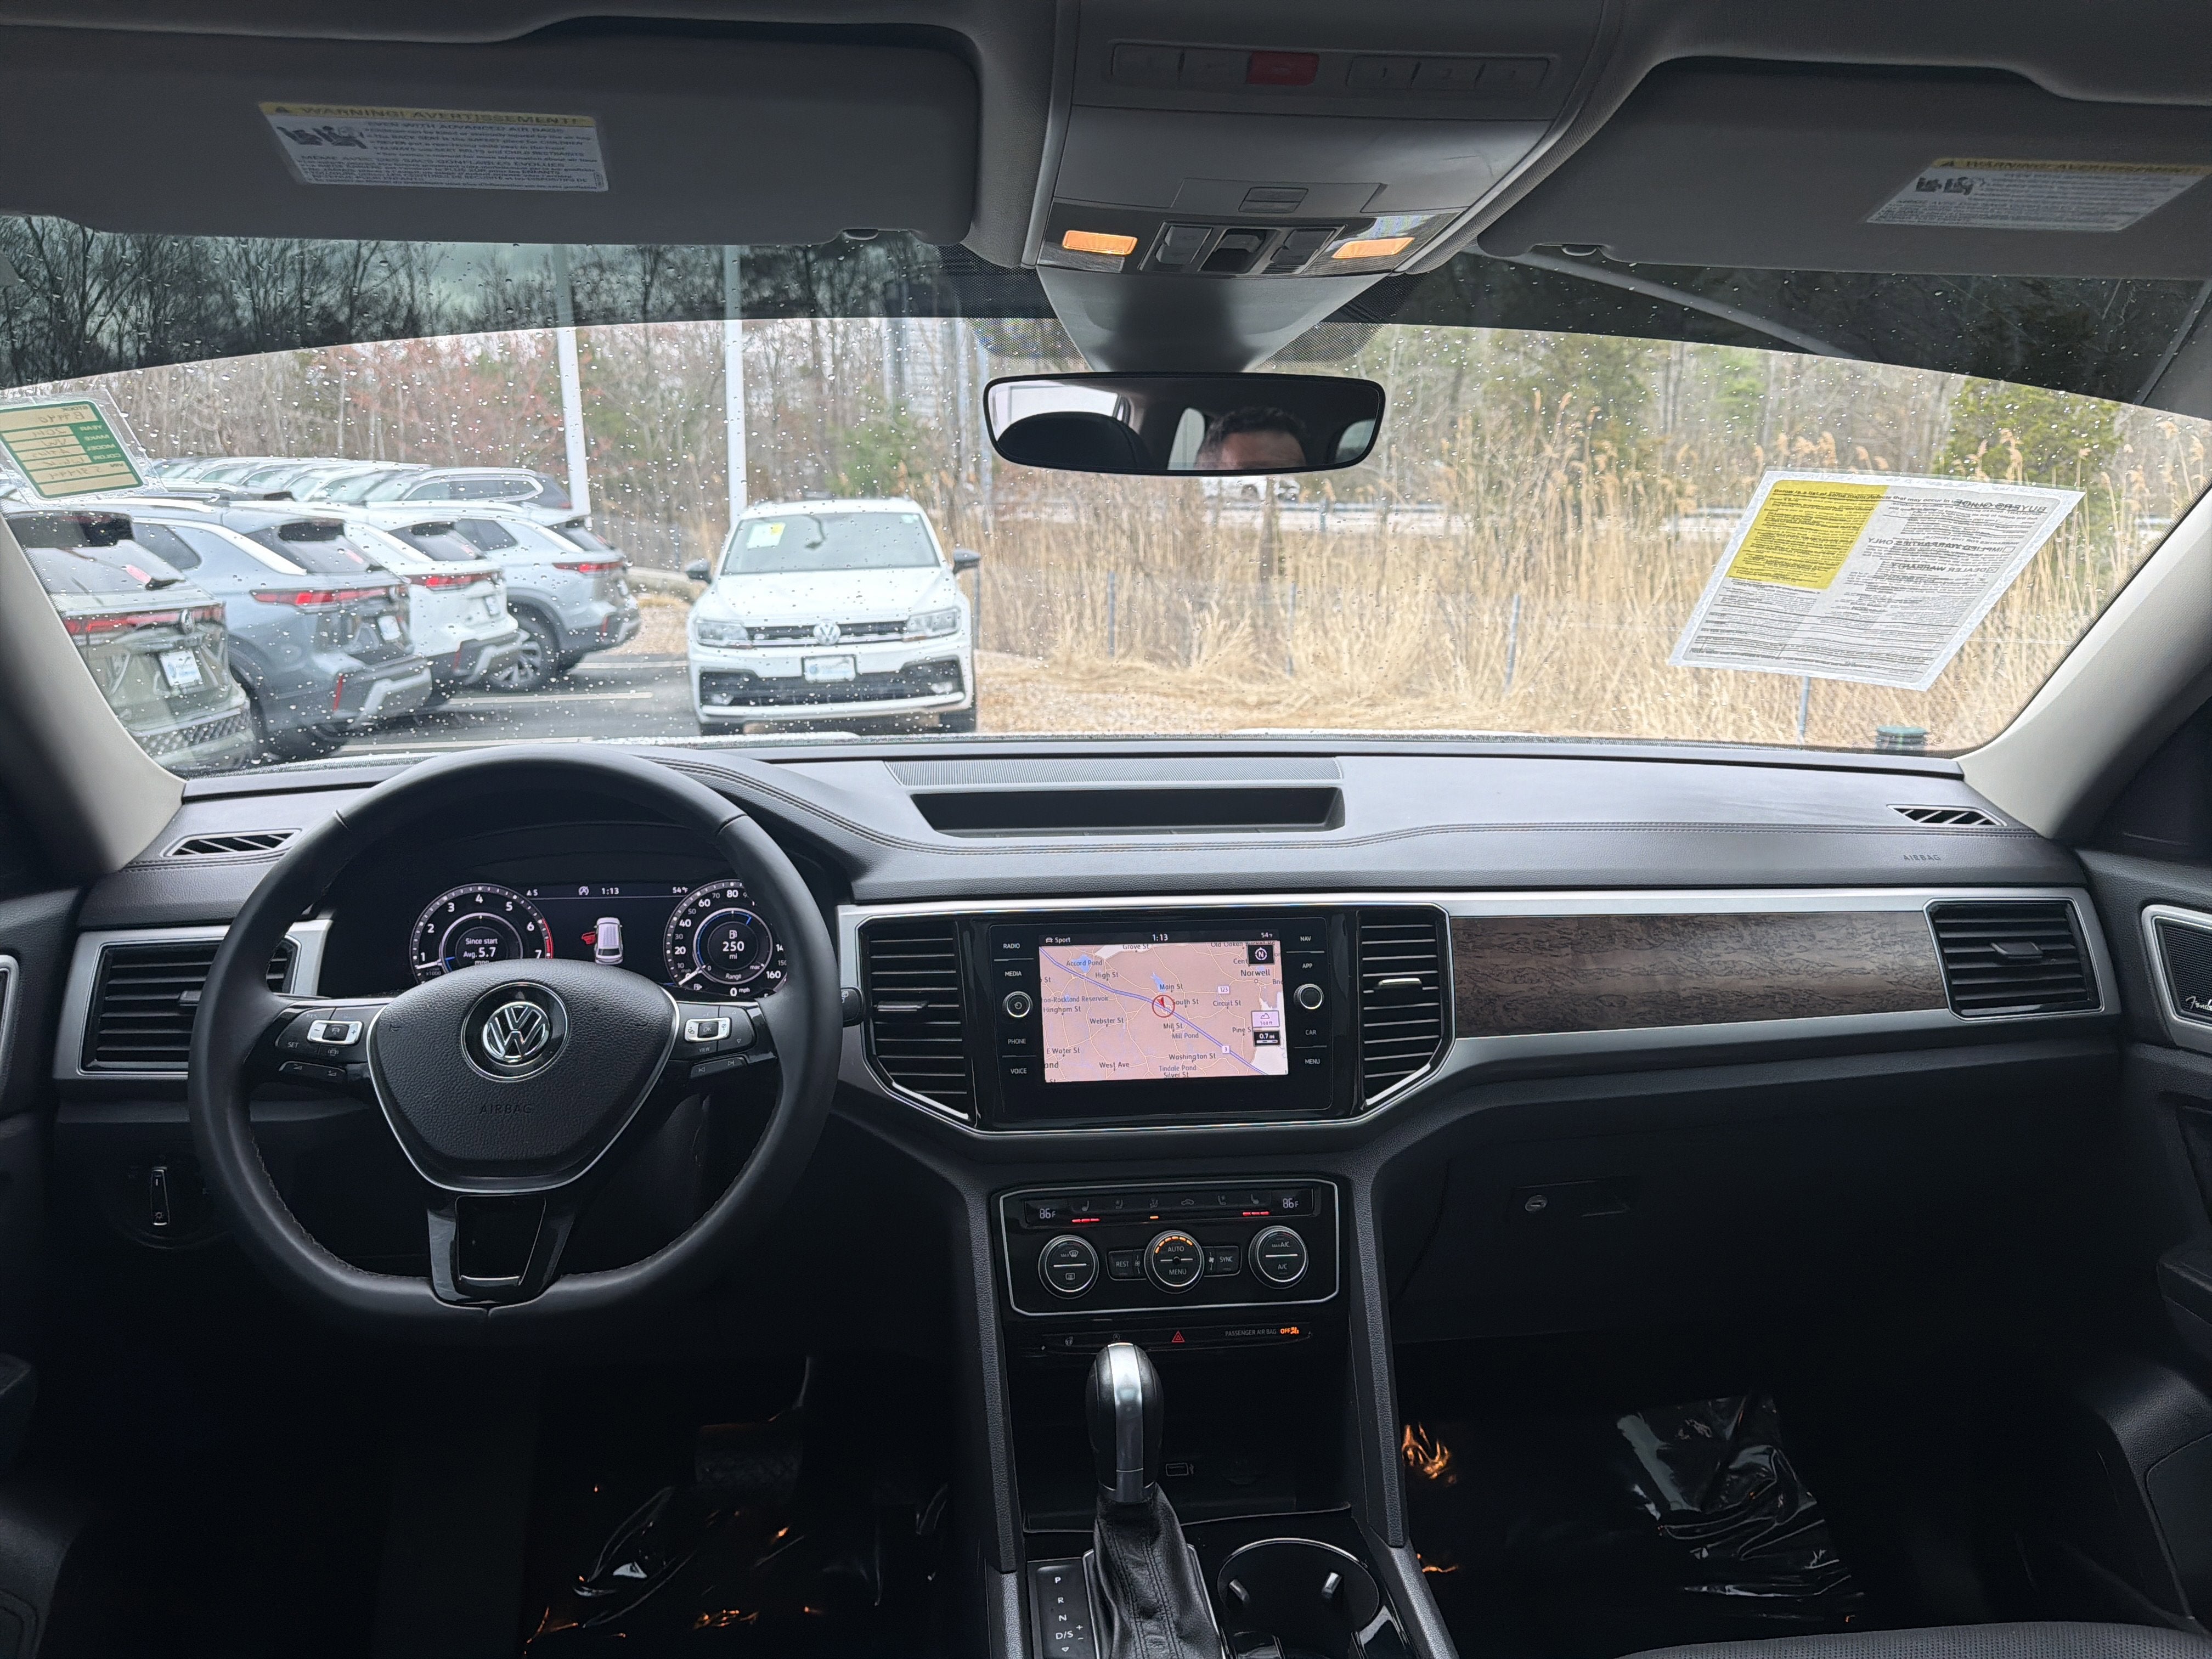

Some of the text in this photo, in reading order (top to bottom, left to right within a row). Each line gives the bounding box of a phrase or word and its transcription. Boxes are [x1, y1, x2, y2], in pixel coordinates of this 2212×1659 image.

[476, 894, 483, 904] 4
[726, 889, 739, 899] 80
[447, 902, 455, 912] 3
[505, 901, 514, 911] 5
[698, 899, 711, 907] 60
[427, 923, 435, 933] 2
[527, 922, 535, 932] 6
[679, 919, 692, 927] 40
[674, 946, 687, 955] 20
[722, 941, 745, 952] 250
[421, 952, 426, 961] 1
[463, 947, 496, 959] Avg. 5.7
[534, 950, 542, 959] 7
[766, 970, 782, 979] 160
[730, 988, 737, 997] 0
[483, 1001, 550, 1063] VW
[479, 1104, 532, 1114] AIRBAG
[1056, 1630, 1074, 1640] D/S
